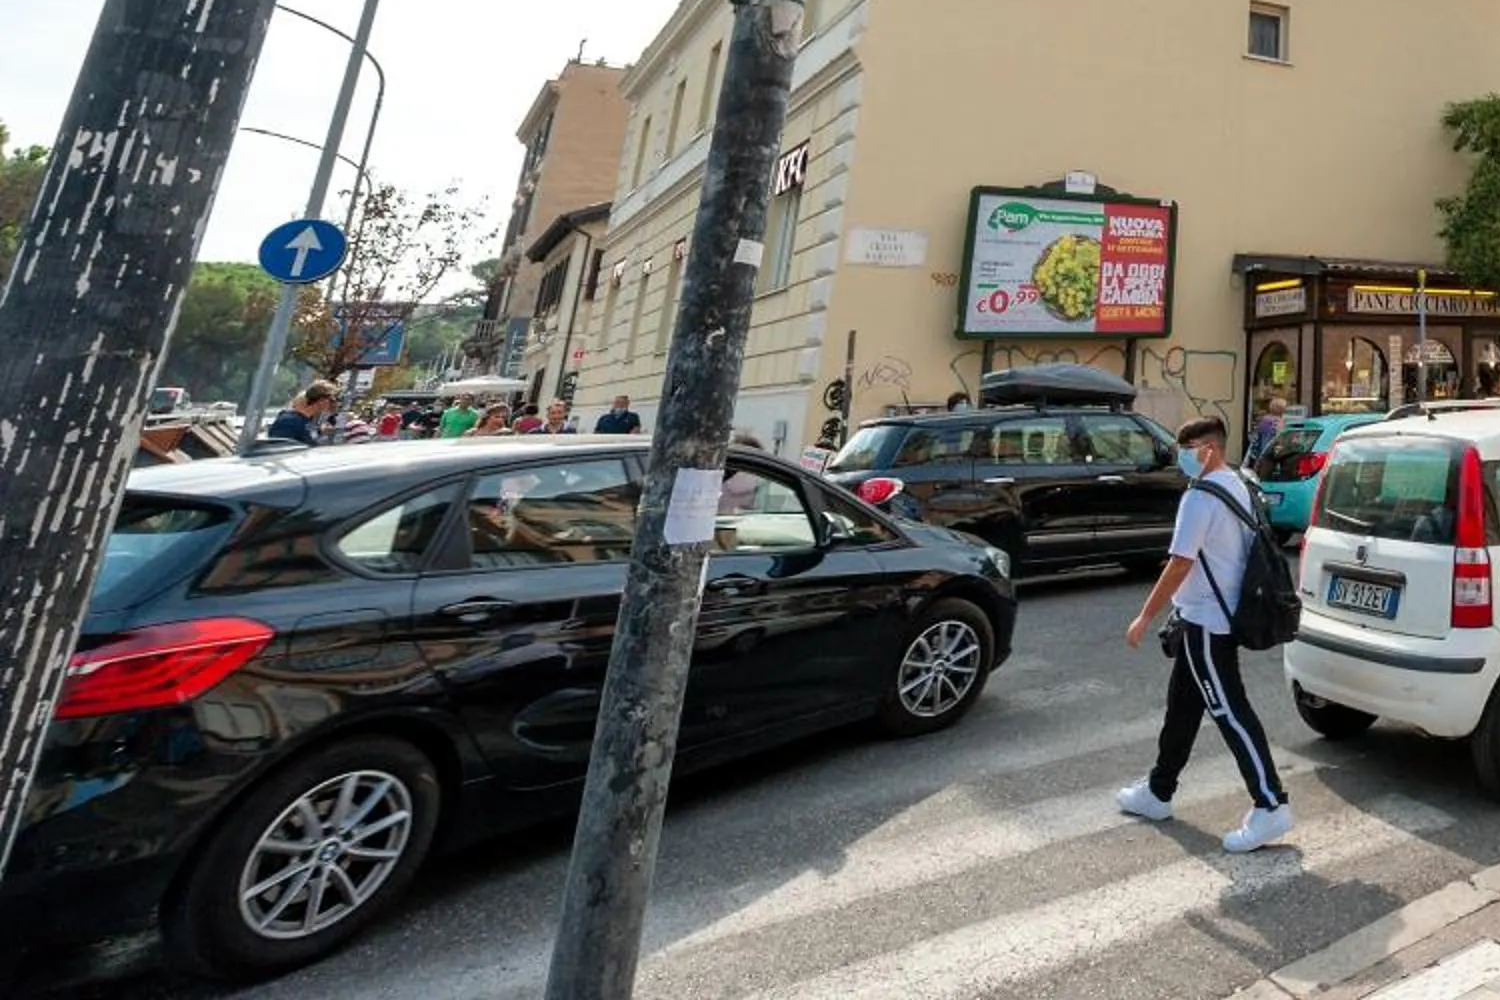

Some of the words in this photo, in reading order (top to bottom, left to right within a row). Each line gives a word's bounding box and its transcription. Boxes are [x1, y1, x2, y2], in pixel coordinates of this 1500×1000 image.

[775, 145, 808, 196] KFC
[997, 209, 1029, 226] Pam
[1109, 215, 1165, 230] NUOVA
[1102, 261, 1124, 277] DA
[1128, 263, 1166, 279] OGGI
[1353, 292, 1396, 311] PANE
